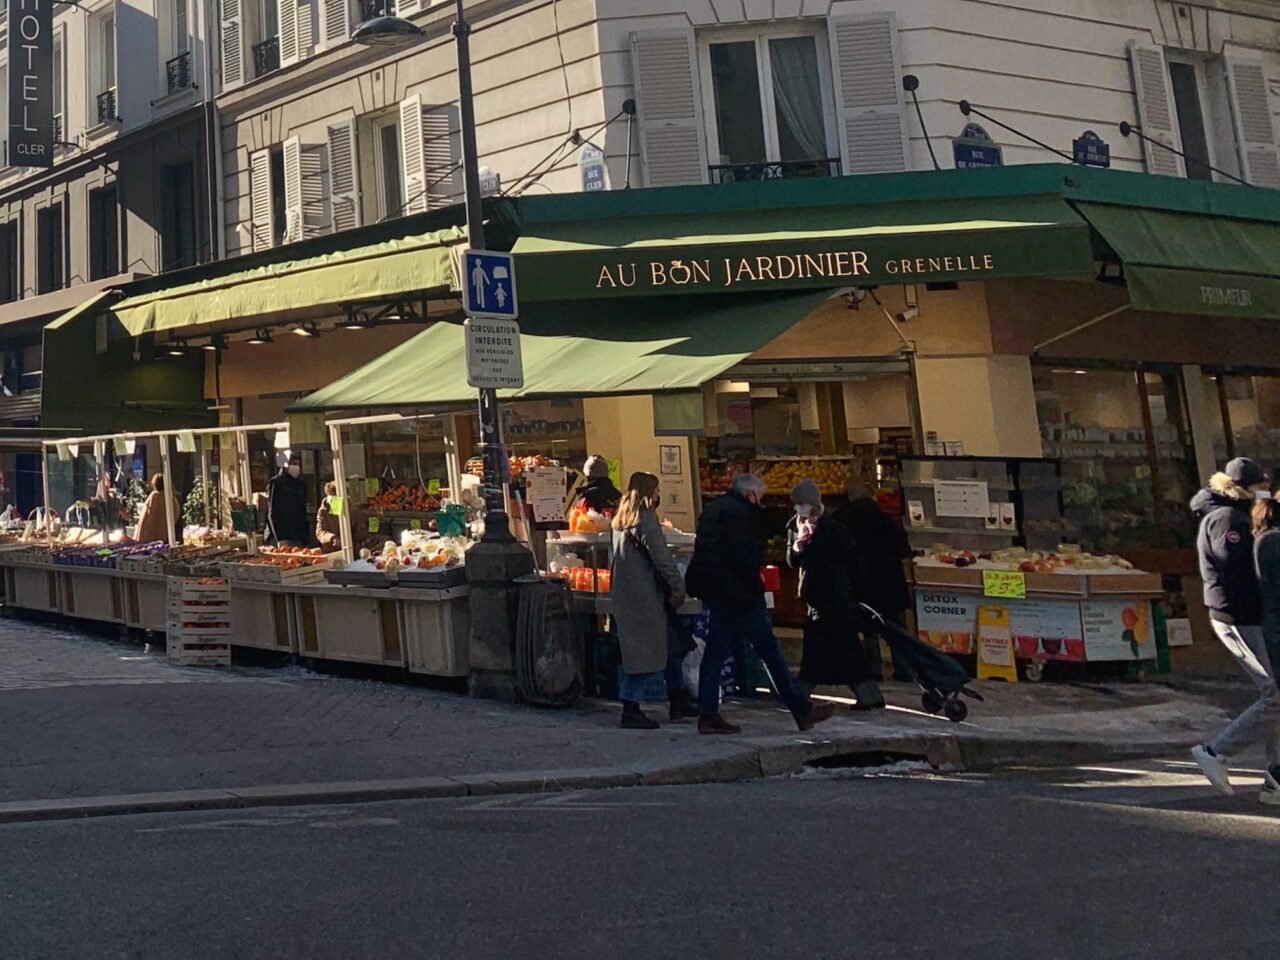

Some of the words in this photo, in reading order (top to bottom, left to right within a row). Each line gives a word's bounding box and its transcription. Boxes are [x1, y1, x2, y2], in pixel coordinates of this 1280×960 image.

[17, 143, 45, 155] CLER
[596, 264, 636, 287] AU
[651, 259, 711, 285] BON
[724, 251, 871, 286] JARDINIER
[885, 254, 994, 274] GRENELLE
[470, 324, 516, 335] CIRCULATION
[475, 336, 513, 346] INTERDITE
[923, 594, 959, 604] DETOX
[923, 605, 967, 616] CORNER
